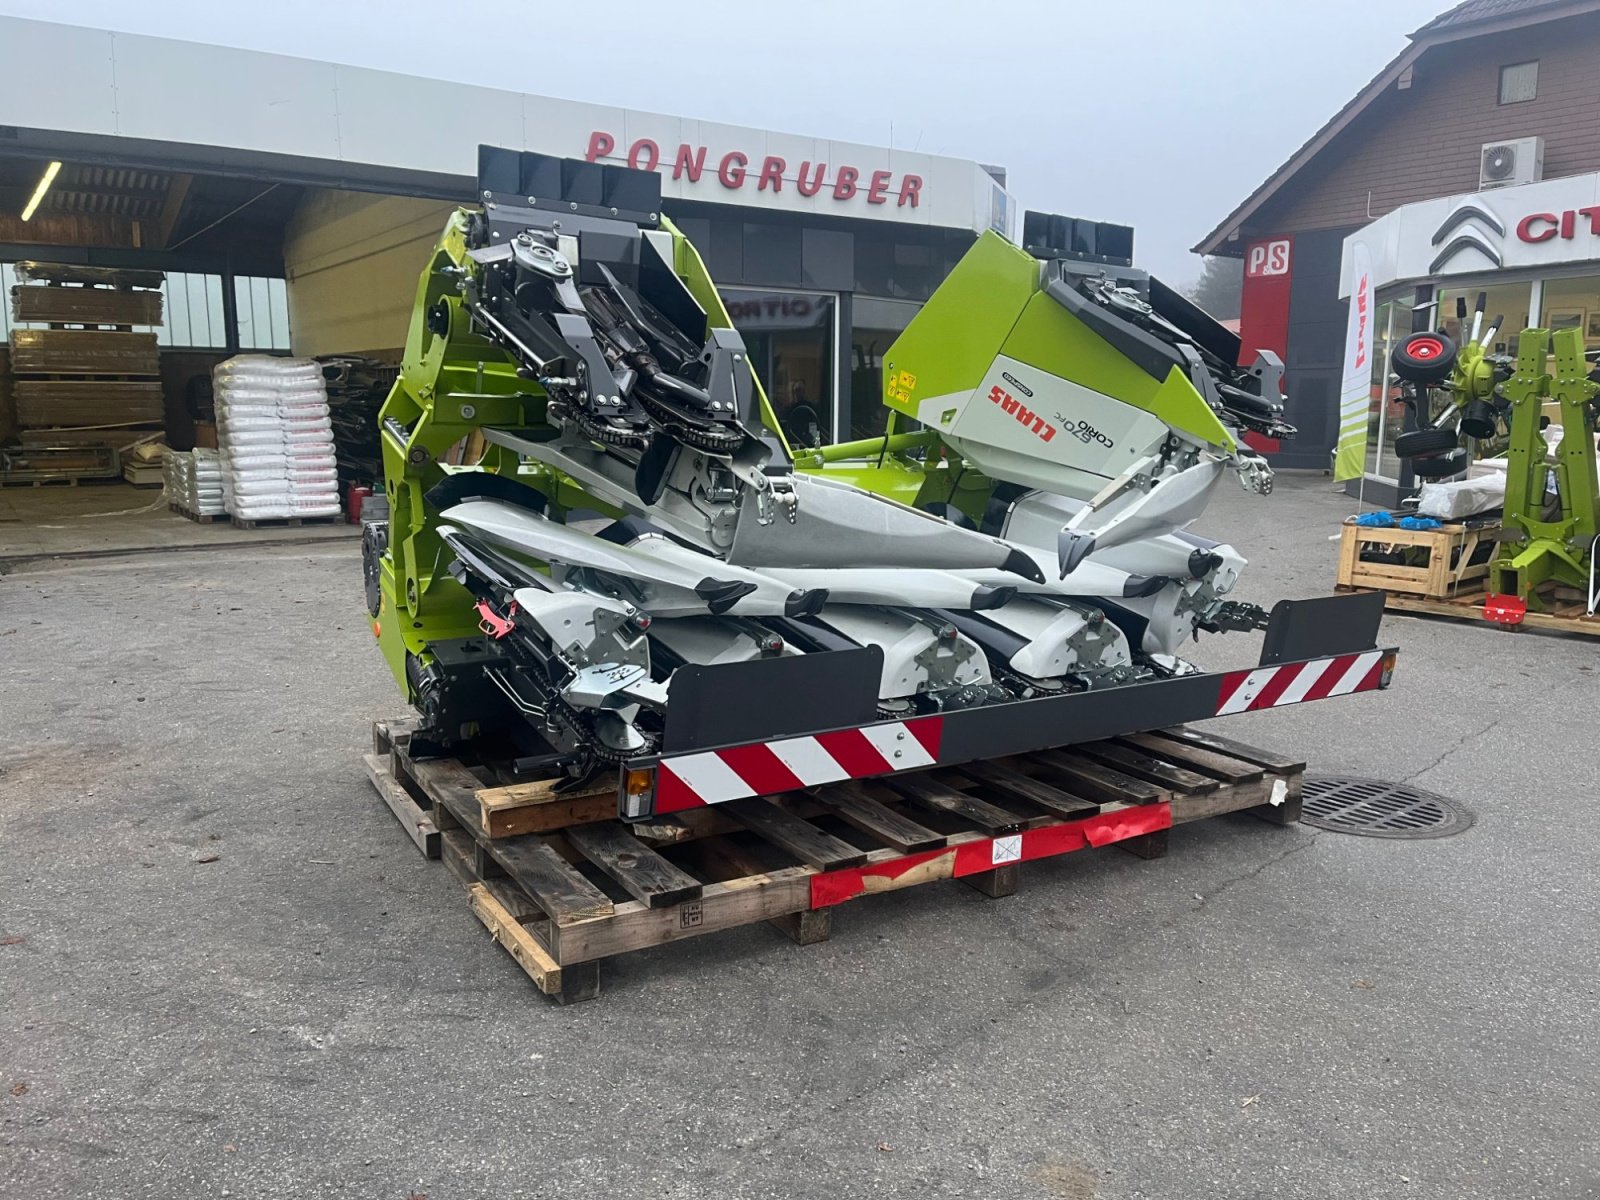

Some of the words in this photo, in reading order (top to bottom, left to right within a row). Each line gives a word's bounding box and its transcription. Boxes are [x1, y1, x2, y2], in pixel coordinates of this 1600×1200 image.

[586, 131, 922, 208] PONGRUBER
[988, 385, 1057, 443] CLAAS
[1064, 420, 1092, 443] 670
[1078, 420, 1114, 449] CORIO
